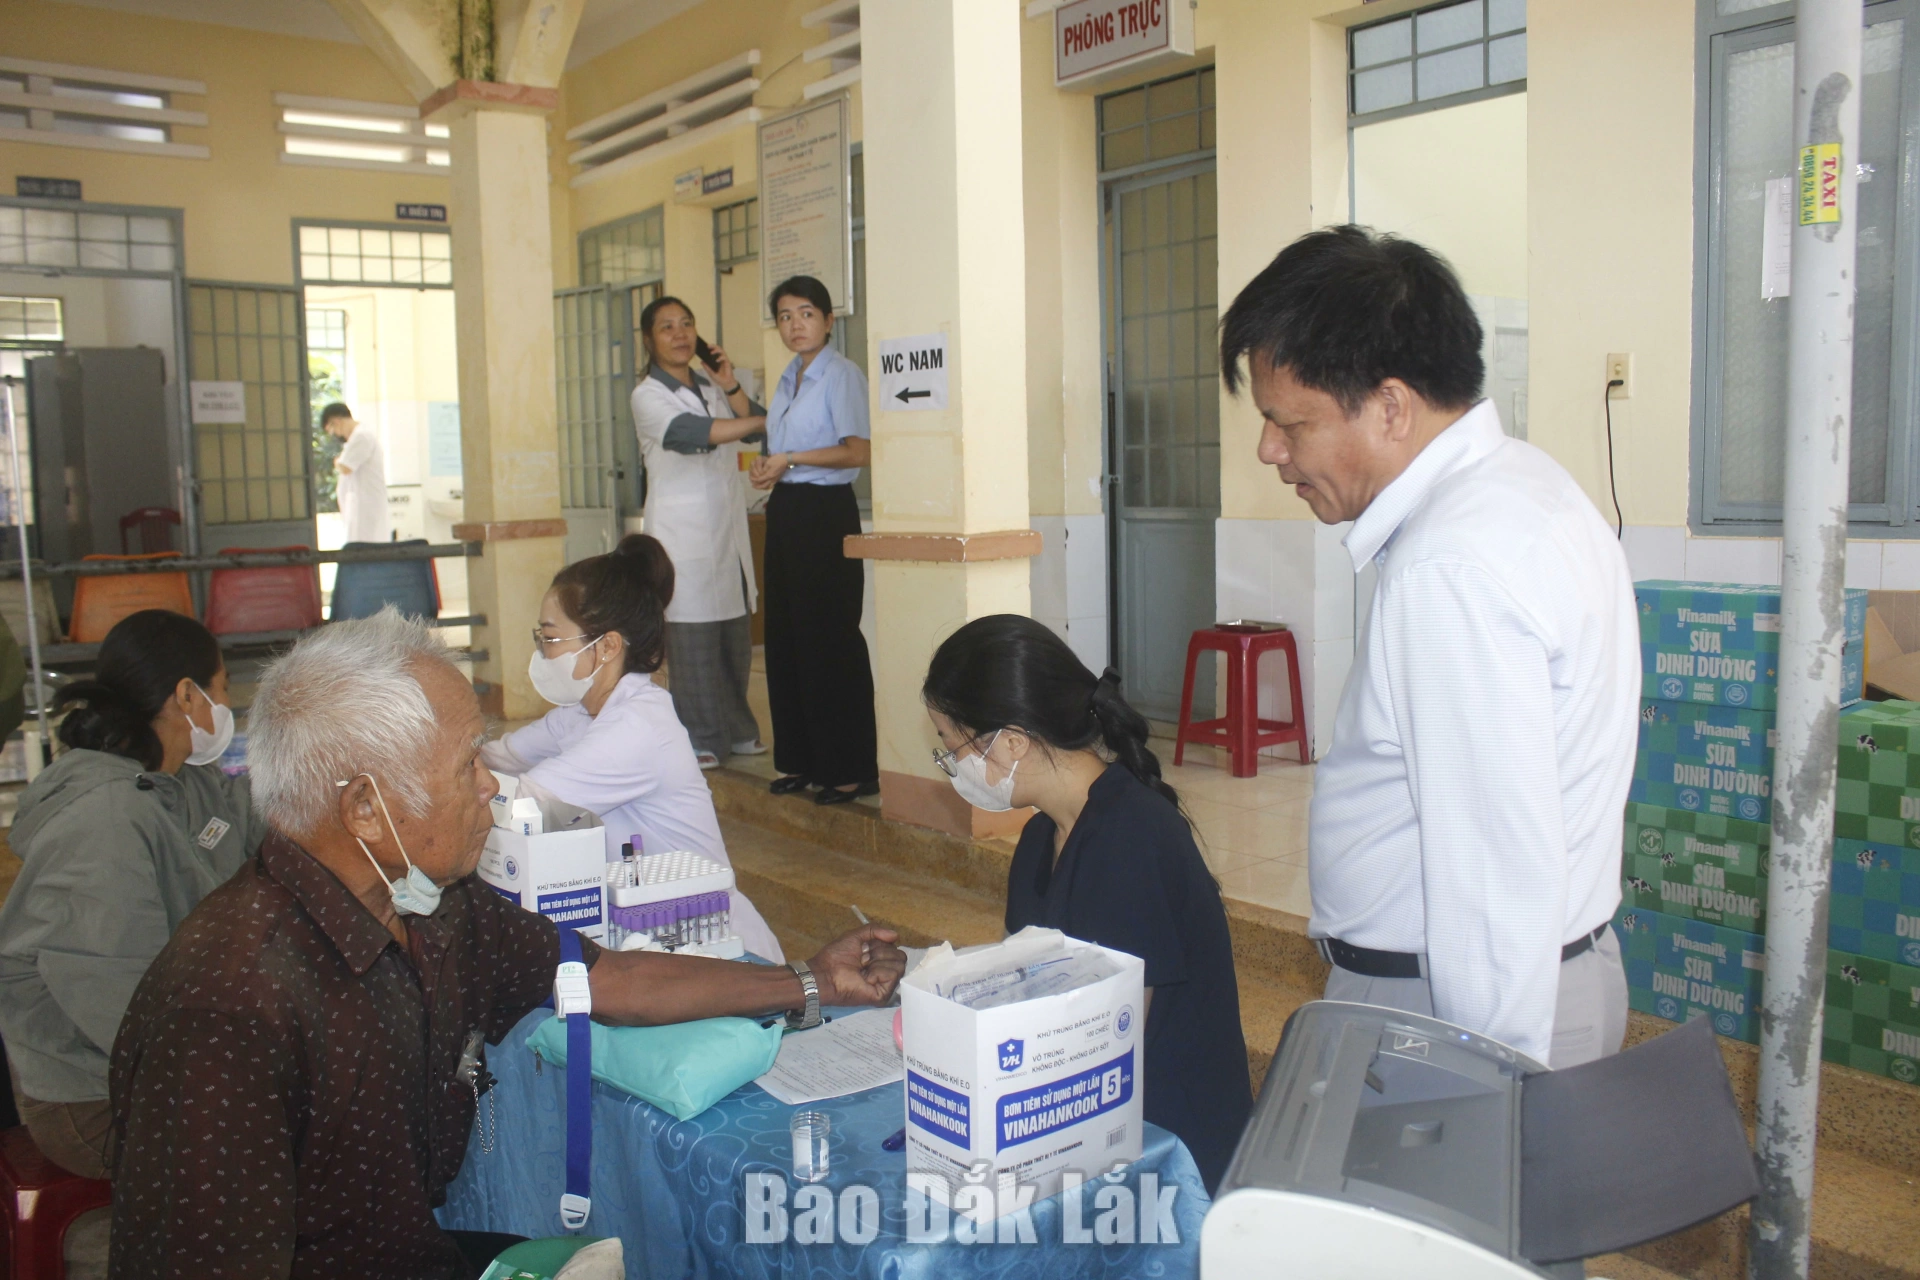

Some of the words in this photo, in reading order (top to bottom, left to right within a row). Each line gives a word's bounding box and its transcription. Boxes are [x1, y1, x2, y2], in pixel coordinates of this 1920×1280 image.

[1823, 157, 1837, 207] TAXI
[881, 352, 904, 374] WC
[909, 347, 943, 371] NAM
[1677, 607, 1737, 625] Vinamilk
[1689, 628, 1722, 653] SỮA
[1656, 652, 1695, 677] DINH
[1697, 655, 1757, 682] DƯỠNG
[1694, 720, 1751, 741] Vinamilk
[1705, 742, 1737, 768] SỮA
[1673, 763, 1710, 789] DINH
[1712, 769, 1770, 798] DƯỠNG
[1683, 836, 1740, 860] Vinamilk
[1693, 861, 1725, 889] SỮA
[1660, 880, 1699, 907] DINH
[1701, 888, 1761, 919] DƯỠNG
[1672, 932, 1727, 959] Vinamilk
[1683, 956, 1713, 983] SỮA
[1652, 971, 1689, 1000] DINH
[1690, 981, 1745, 1015] DƯỠNG
[1031, 1060, 1053, 1073] KHÔNG
[1107, 1073, 1117, 1097] 5
[1004, 1103, 1022, 1118] BƠM
[1023, 1096, 1041, 1110] TIÊM
[1042, 1088, 1052, 1106] SỬ
[1053, 1089, 1071, 1105] DỤNG
[1072, 1080, 1087, 1098] MỘT
[909, 1096, 968, 1138] VINAHANKOOK
[1003, 1093, 1099, 1142] VINAHANKOOK
